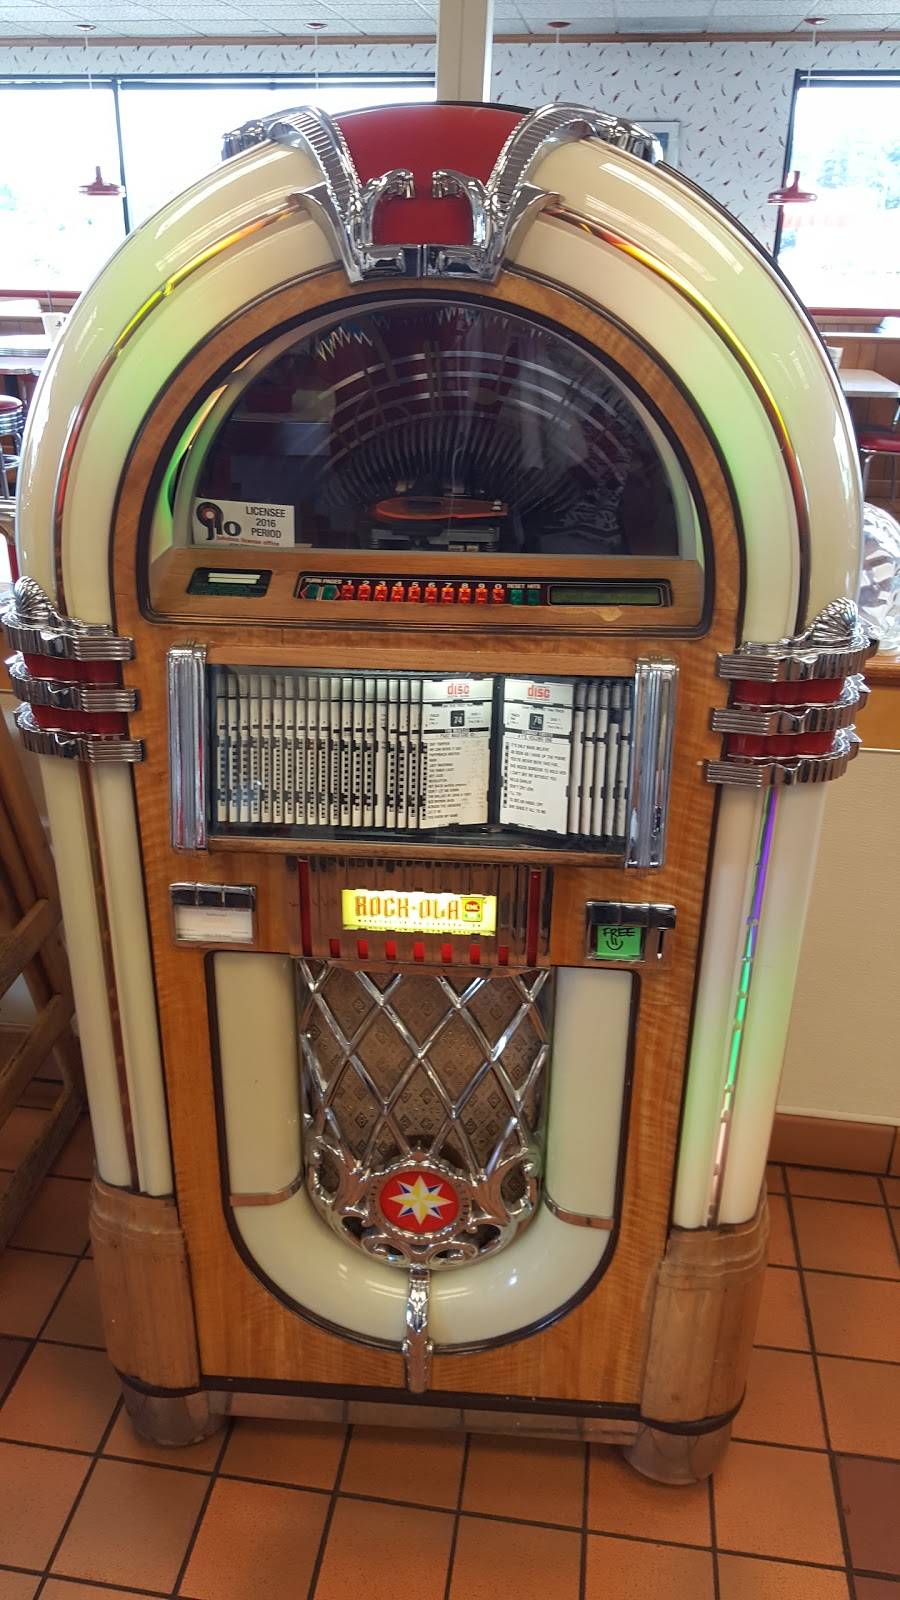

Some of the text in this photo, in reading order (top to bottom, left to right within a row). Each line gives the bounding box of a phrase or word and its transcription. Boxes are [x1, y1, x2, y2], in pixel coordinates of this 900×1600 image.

[245, 506, 286, 518] LICENSEE
[255, 518, 276, 528] 2016
[251, 527, 282, 538] PERIOD
[447, 683, 470, 695] disc
[528, 684, 550, 698] disc
[602, 927, 636, 938] FREE
